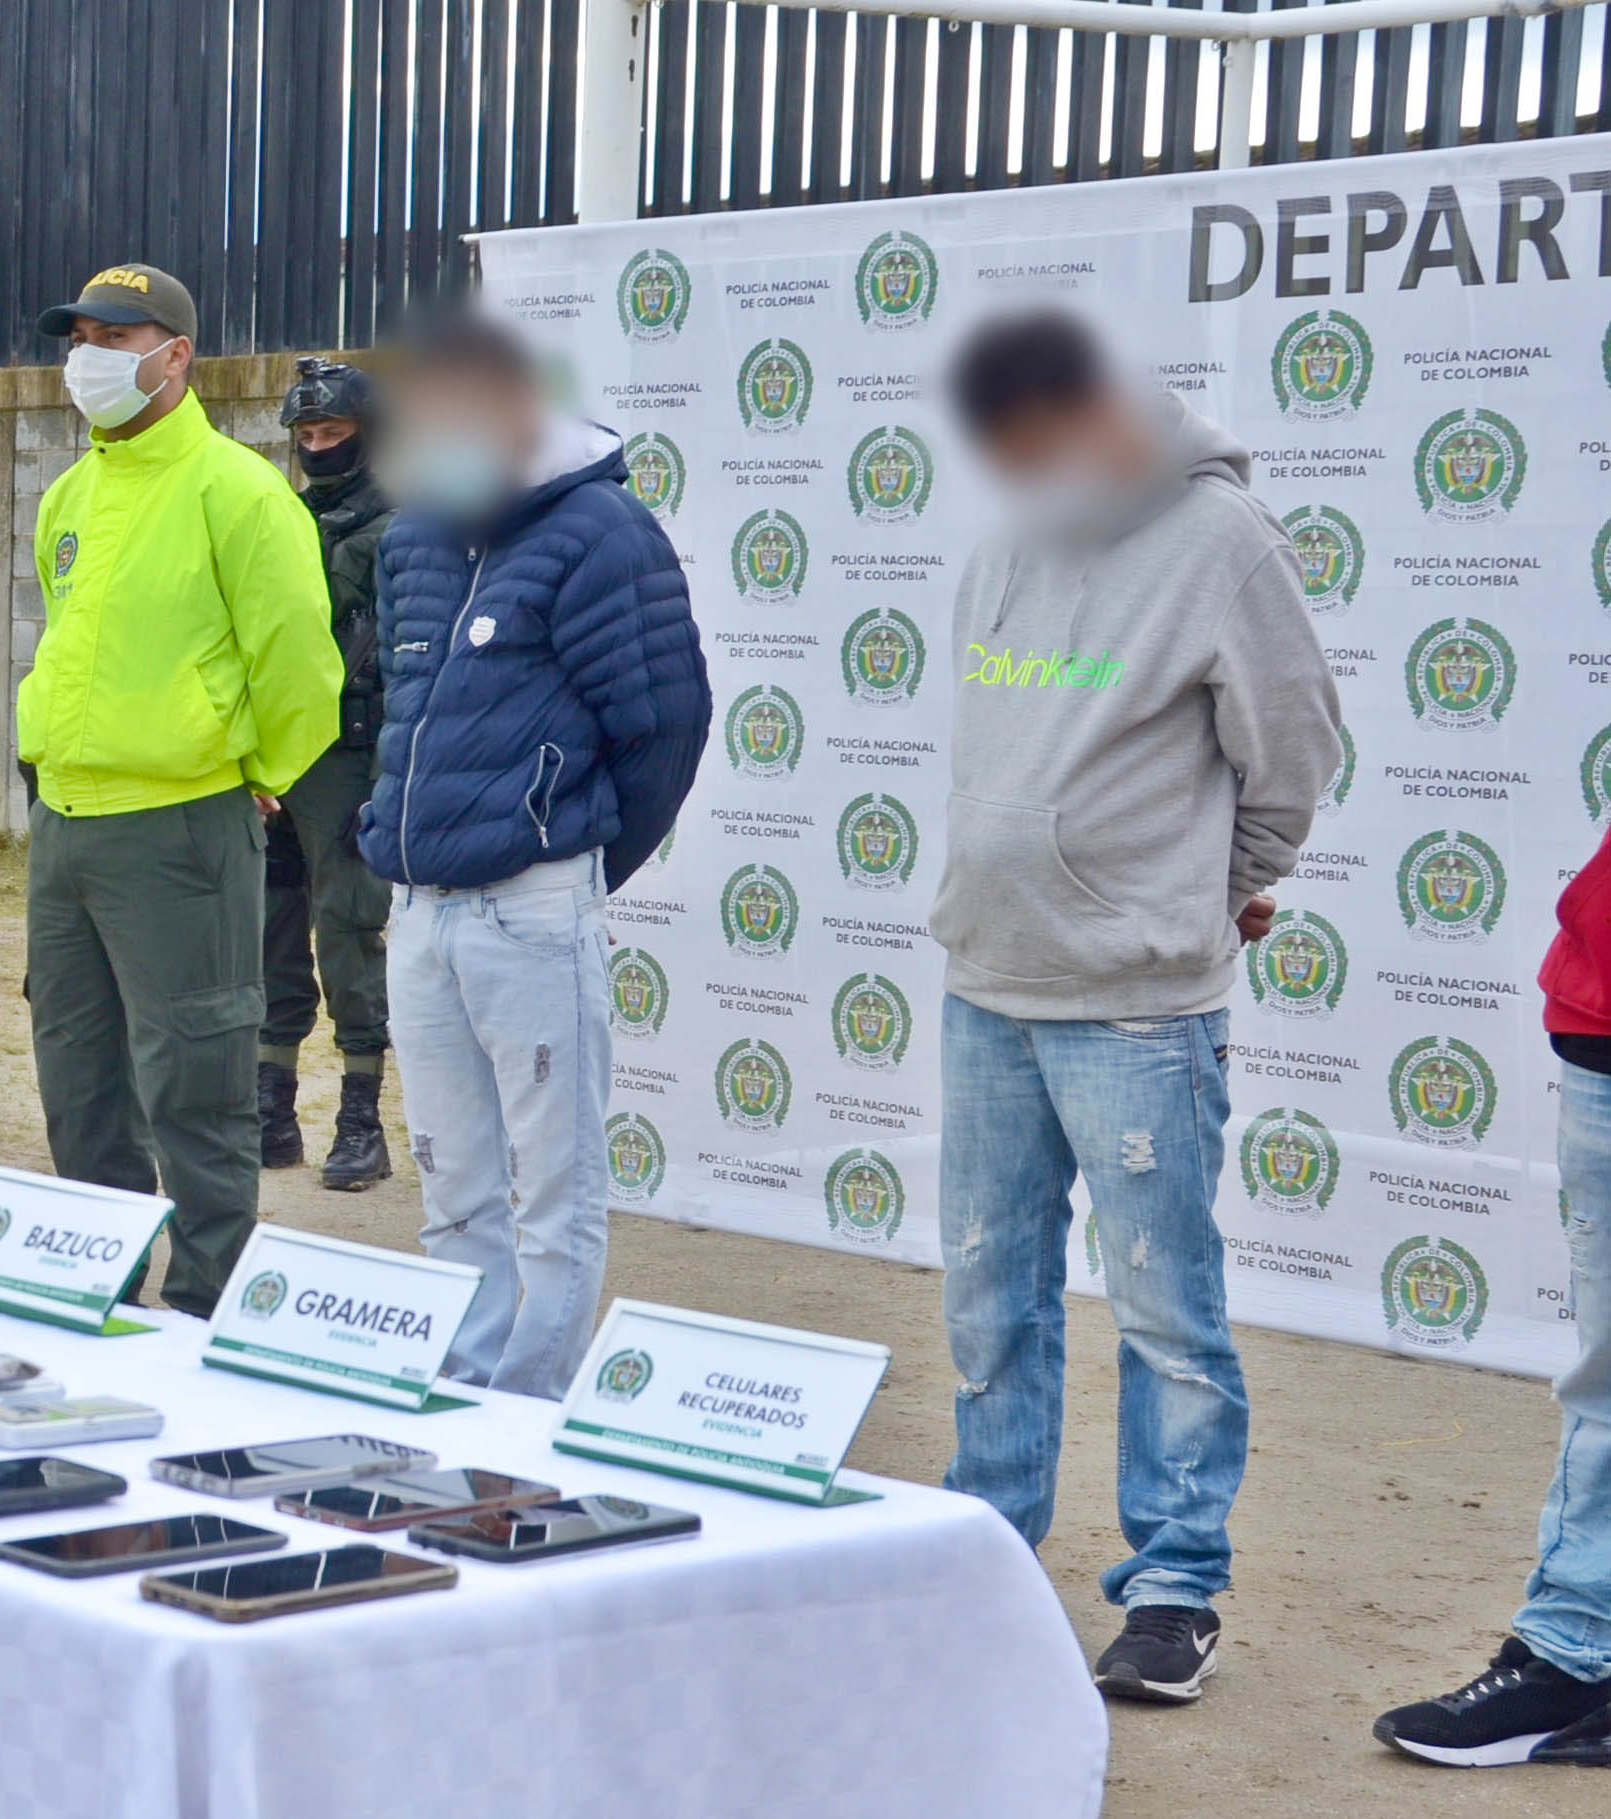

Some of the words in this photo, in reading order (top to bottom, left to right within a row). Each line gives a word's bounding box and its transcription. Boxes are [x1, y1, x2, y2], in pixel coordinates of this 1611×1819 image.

[1027, 260, 1097, 277] NACIONAL
[725, 282, 769, 296] POLICÍA
[770, 278, 831, 293] NACIONAL
[542, 293, 596, 306] NACIONAL
[740, 297, 755, 310] DE
[756, 294, 816, 309] COLOMBIA
[1403, 347, 1461, 365] POLICÍA
[1465, 346, 1553, 363] NACIONAL
[1158, 361, 1227, 376] NACIONAL
[1420, 368, 1439, 382] DE
[1442, 364, 1530, 381] COLOMBIA
[603, 382, 645, 396] POLICÍA
[646, 382, 703, 395] NACIONAL
[837, 372, 884, 388] POLICÍA
[616, 398, 630, 410] DE
[632, 396, 687, 410] COLOMBIA
[852, 390, 868, 403] DE
[1251, 447, 1307, 463] POLICÍA
[1310, 447, 1387, 462] NACIONAL
[721, 458, 766, 472] POLICÍA
[767, 458, 825, 471] NACIONAL
[1269, 465, 1288, 479] DE
[1291, 464, 1367, 479] COLOMBIA
[735, 474, 751, 486] DE
[752, 473, 810, 487] COLOMBIA
[831, 552, 878, 567] POLICÍA
[880, 554, 946, 567] NACIONAL
[1393, 553, 1452, 570] POLICÍA
[1455, 556, 1542, 570] NACIONAL
[844, 569, 861, 582] DE
[863, 569, 928, 582] COLOMBIA
[1411, 574, 1431, 587] DE
[1434, 574, 1520, 587] COLOMBIA
[715, 632, 761, 644] POLICÍA
[762, 633, 821, 646] NACIONAL
[729, 647, 745, 659] DE
[747, 647, 805, 660] COLOMBIA
[1588, 671, 1610, 684] DE
[826, 736, 871, 750] POLICÍA
[873, 738, 938, 754] NACIONAL
[839, 752, 855, 765] DE
[856, 752, 920, 768] COLOMBIA
[1384, 765, 1443, 781] POLICÍA
[1446, 768, 1532, 785] NACIONAL
[1402, 783, 1422, 797] DE
[1425, 784, 1509, 801] COLOMBIA
[710, 808, 754, 823] POLICÍA
[755, 811, 816, 827] NACIONAL
[723, 823, 739, 836] DE
[740, 824, 801, 840] COLOMBIA
[633, 899, 687, 914] NACIONAL
[616, 910, 672, 927] COLOMBIA
[822, 916, 865, 931] POLICÍA
[866, 920, 930, 938] NACIONAL
[835, 932, 850, 945] DE
[851, 934, 914, 951] COLOMBIA
[1376, 970, 1434, 989] POLICÍA
[1437, 976, 1521, 996] NACIONAL
[705, 982, 749, 998] POLICÍA
[750, 987, 810, 1005] NACIONAL
[1394, 989, 1413, 1004] DE
[1416, 991, 1500, 1011] COLOMBIA
[719, 998, 734, 1011] DE
[735, 1000, 794, 1018] COLOMBIA
[1229, 1043, 1282, 1061] POLICÍA
[1285, 1049, 1361, 1071] NACIONAL
[628, 1065, 680, 1085] NACIONAL
[1245, 1061, 1263, 1076] DE
[1265, 1064, 1342, 1085] COLOMBIA
[614, 1077, 666, 1096] COLOMBIA
[815, 1091, 861, 1109] POLICÍA
[862, 1097, 924, 1120] NACIONAL
[829, 1107, 845, 1122] DE
[847, 1110, 907, 1131] COLOMBIA
[697, 1151, 743, 1168] POLICÍA
[745, 1158, 804, 1179] NACIONAL
[712, 1167, 728, 1182] DE
[729, 1170, 788, 1190] COLOMBIA
[1369, 1170, 1426, 1191] POLICÍA
[1428, 1179, 1512, 1203] NACIONAL
[1386, 1189, 1405, 1205] DE
[1408, 1192, 1491, 1216] COLOMBIA
[23, 1225, 124, 1262] BAZUCO
[1277, 1244, 1353, 1269] NACIONAL
[1237, 1254, 1256, 1269] DE
[1258, 1257, 1333, 1282] COLOMBIA
[294, 1289, 433, 1341] GRAMERA
[704, 1371, 804, 1404] CELULARES
[677, 1390, 809, 1430] RECUPERADOS
[701, 1418, 763, 1439] EVIDENCIA
